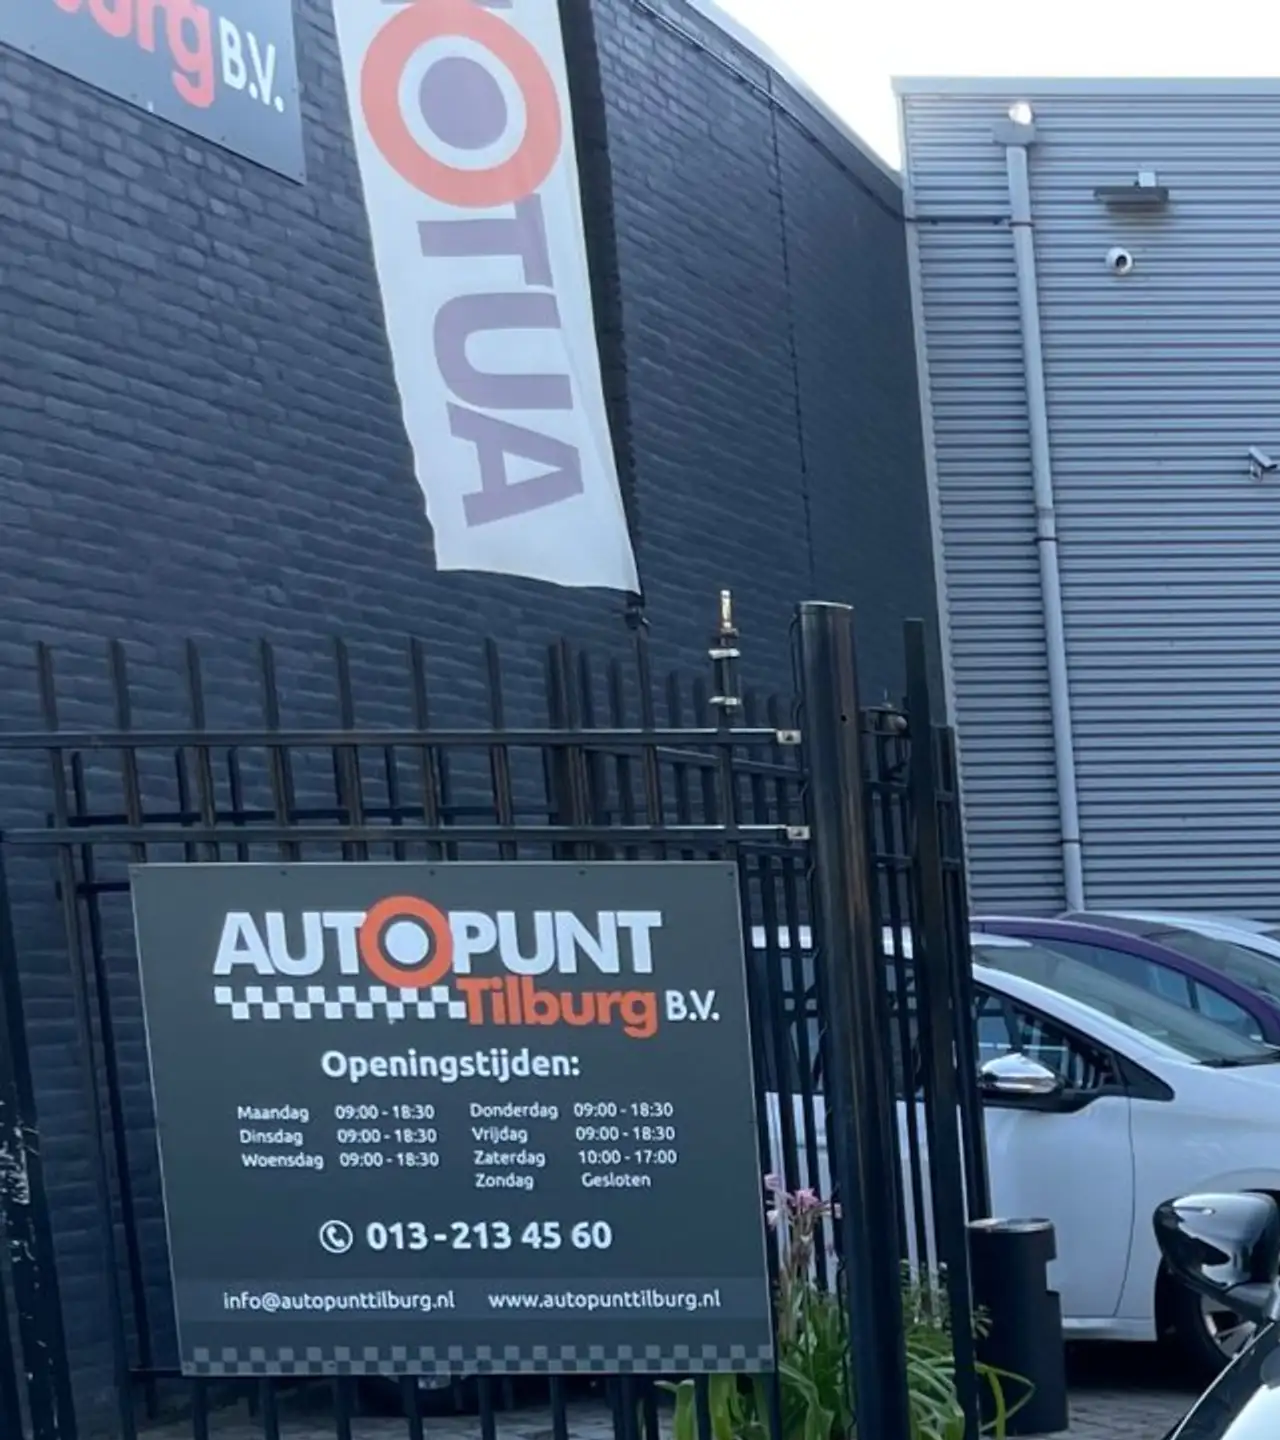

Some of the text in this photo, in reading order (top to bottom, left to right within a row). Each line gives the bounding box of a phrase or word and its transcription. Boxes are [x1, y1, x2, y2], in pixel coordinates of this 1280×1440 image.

[56, 0, 284, 113] urg B.V.
[212, 895, 663, 988] AUTOPUNT
[455, 974, 720, 1038] Tilburg B.V.
[321, 1047, 580, 1083] Openingstijden:
[237, 1105, 309, 1123] Maandag
[334, 1104, 378, 1119] 09:00
[392, 1104, 435, 1119] 18:30
[470, 1102, 558, 1120] Donderdag
[574, 1102, 617, 1117] 09:00
[631, 1102, 673, 1117] 18:30
[240, 1128, 303, 1146] Dinsdag
[337, 1128, 381, 1143] 09:00
[394, 1128, 437, 1143] 18:30
[471, 1126, 528, 1143] Vrijdag
[575, 1126, 619, 1141] 09:00
[632, 1126, 675, 1140] 18:30
[241, 1152, 324, 1170] Woensdag
[339, 1152, 383, 1167] 09:00
[397, 1152, 439, 1167] 18:30
[473, 1150, 546, 1167] Zaterdag
[578, 1150, 621, 1164] 10:00
[635, 1150, 677, 1164] 17:00
[475, 1172, 651, 1190] Zondag Gesloten
[521, 1221, 562, 1249] 45
[571, 1220, 613, 1249] 60
[223, 1289, 721, 1312] info@autopunttilburg.nl www.autopunttilburg.nl
